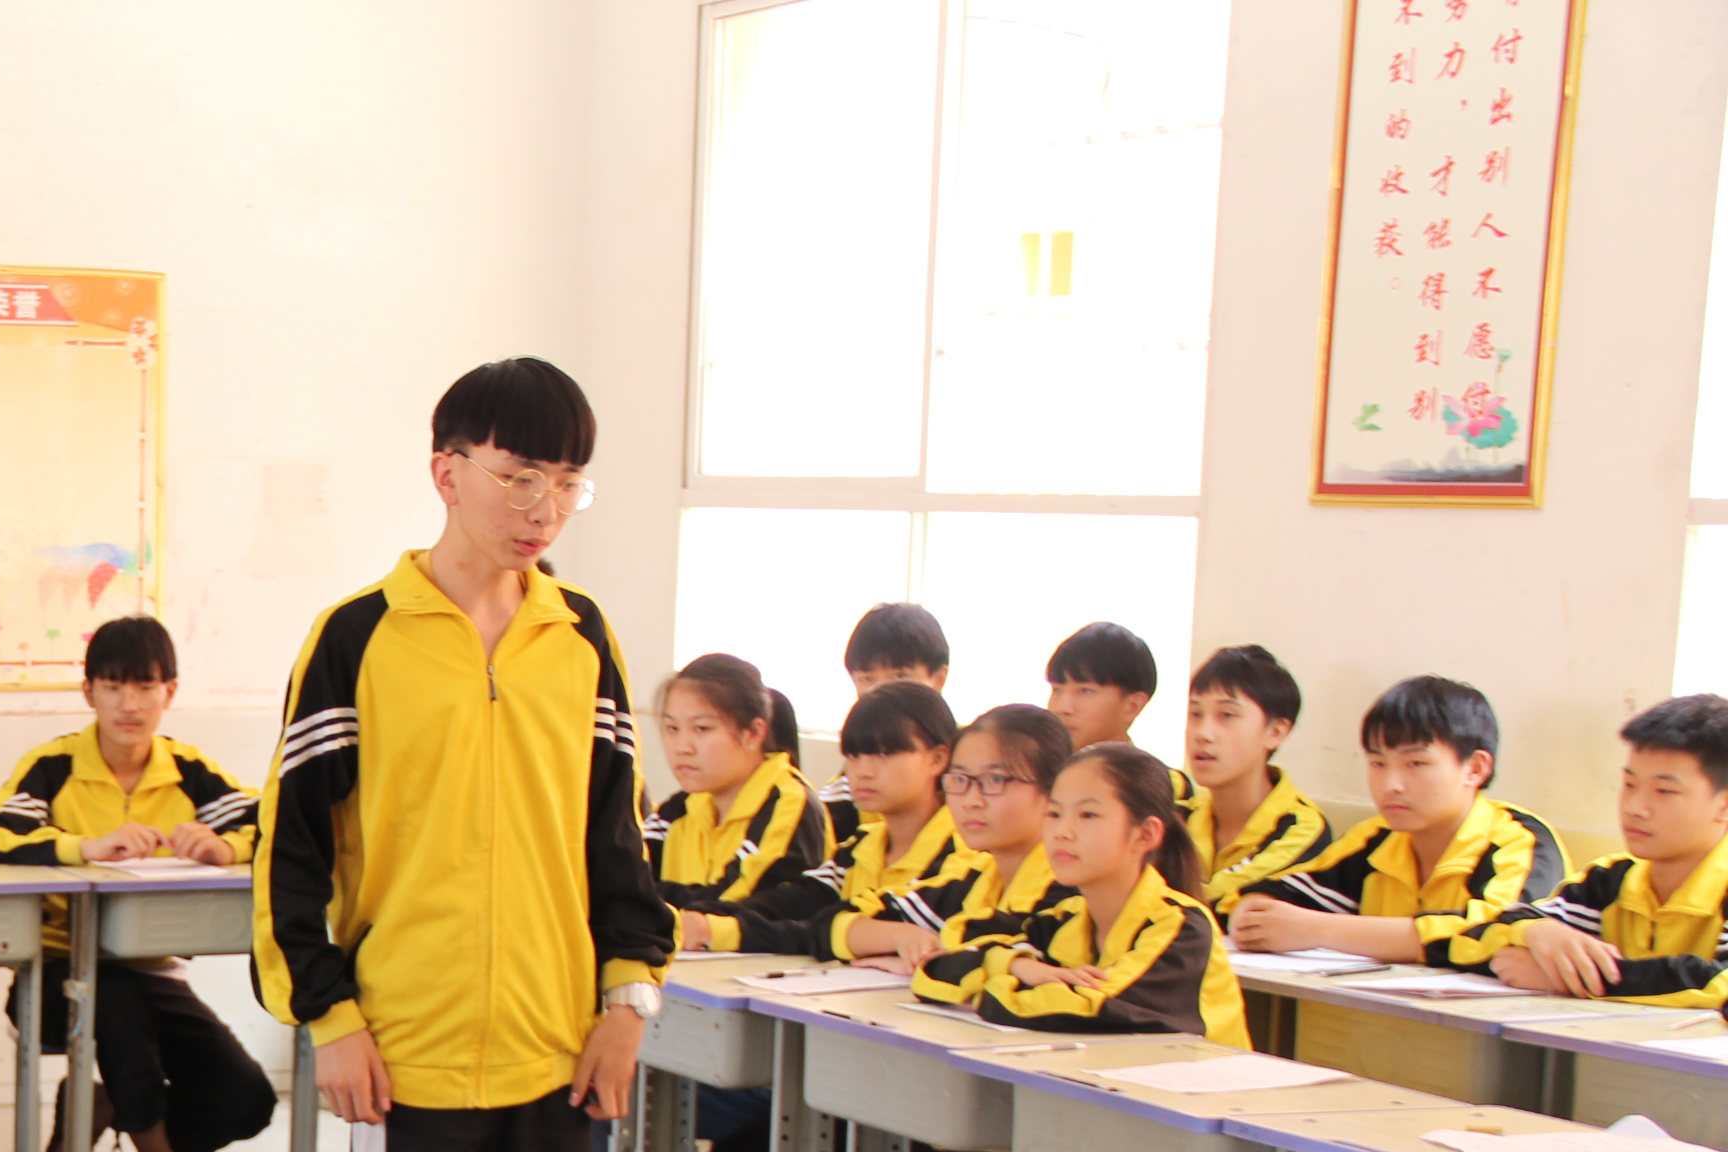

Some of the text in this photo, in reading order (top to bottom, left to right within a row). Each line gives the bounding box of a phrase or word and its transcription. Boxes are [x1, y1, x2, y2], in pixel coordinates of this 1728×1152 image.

[1462, 0, 1523, 418] 付出别人不愿付
